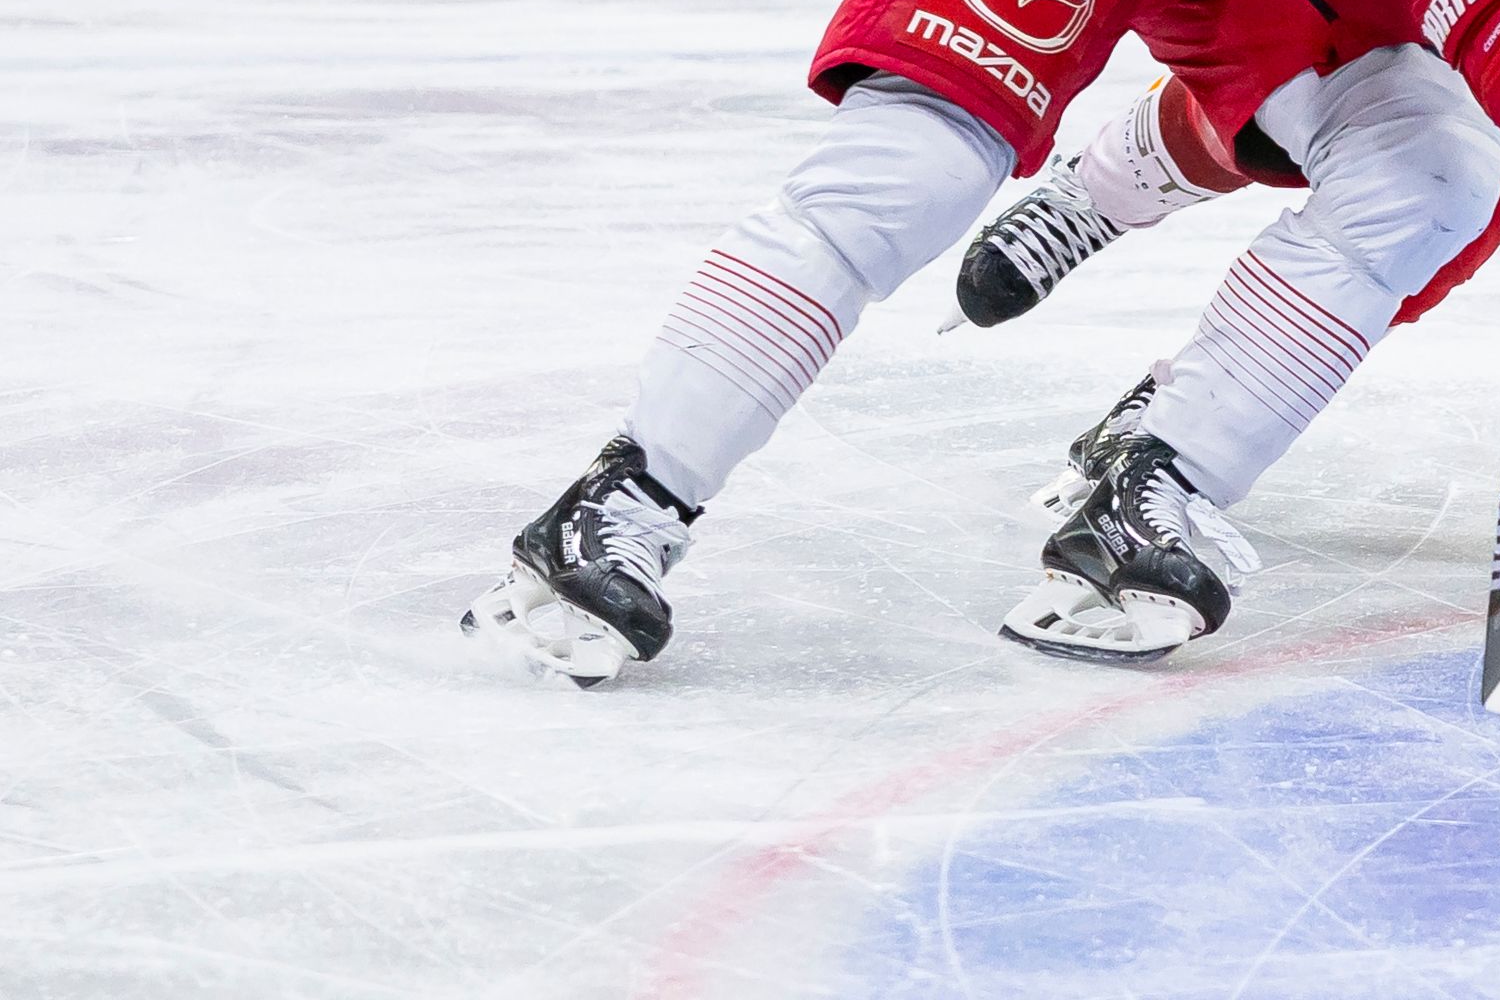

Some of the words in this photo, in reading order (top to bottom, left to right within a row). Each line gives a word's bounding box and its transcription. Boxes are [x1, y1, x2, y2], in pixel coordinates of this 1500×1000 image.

[906, 9, 1052, 121] mazda
[560, 520, 578, 566] BAUER
[1098, 513, 1130, 555] BAUER
